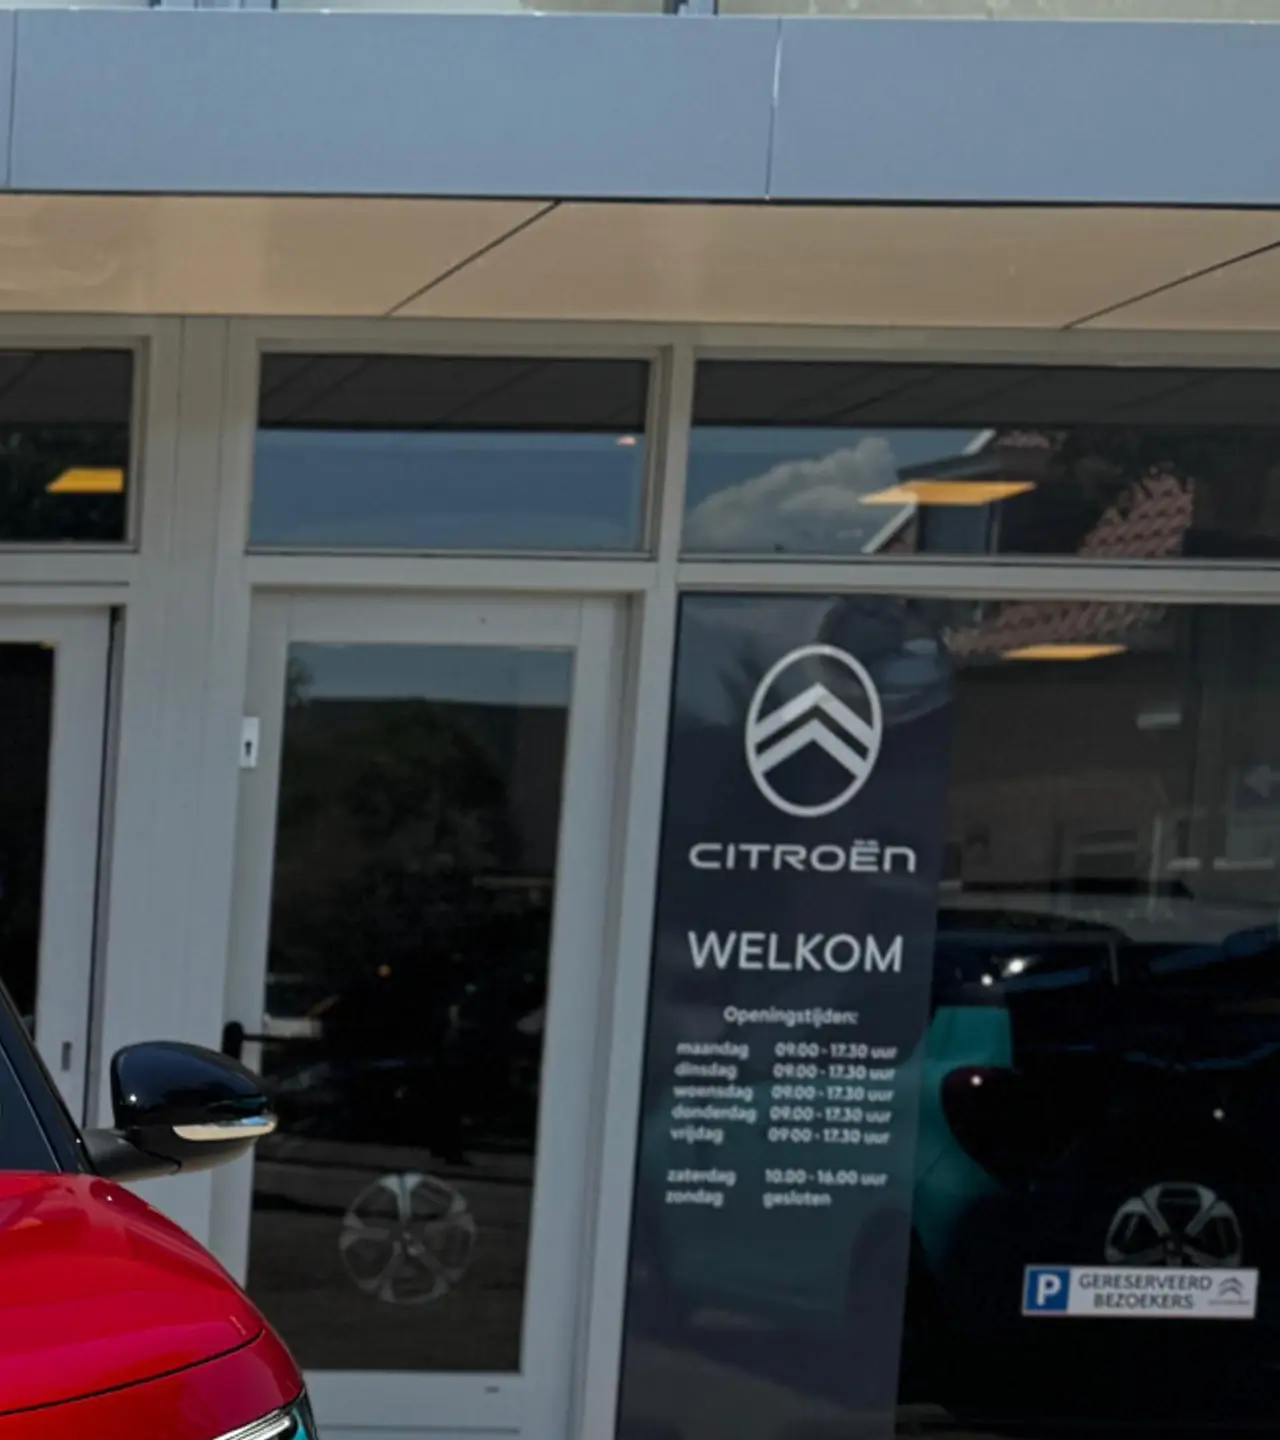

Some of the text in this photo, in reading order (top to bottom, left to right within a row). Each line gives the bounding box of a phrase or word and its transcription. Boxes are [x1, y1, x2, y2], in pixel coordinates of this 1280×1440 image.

[687, 930, 904, 973] WELKOM
[723, 1005, 858, 1028] Openingstijden:
[676, 1041, 750, 1060] maandag
[871, 1046, 898, 1059] uur
[674, 1062, 738, 1081] dinsdag
[869, 1068, 896, 1080] uur
[673, 1083, 754, 1102] woensdag
[867, 1090, 894, 1102] uur
[671, 1104, 758, 1124] donderdag
[865, 1111, 892, 1123] uur
[670, 1125, 725, 1145] vrijdag
[863, 1132, 890, 1144] uur
[667, 1167, 737, 1187] zaterdag
[860, 1174, 888, 1186] uur
[666, 1189, 832, 1209] zondag gesloten
[1037, 1274, 1062, 1306] P
[1078, 1273, 1213, 1291] GERESERVEERD
[1094, 1293, 1194, 1310] BEZOEKERS
